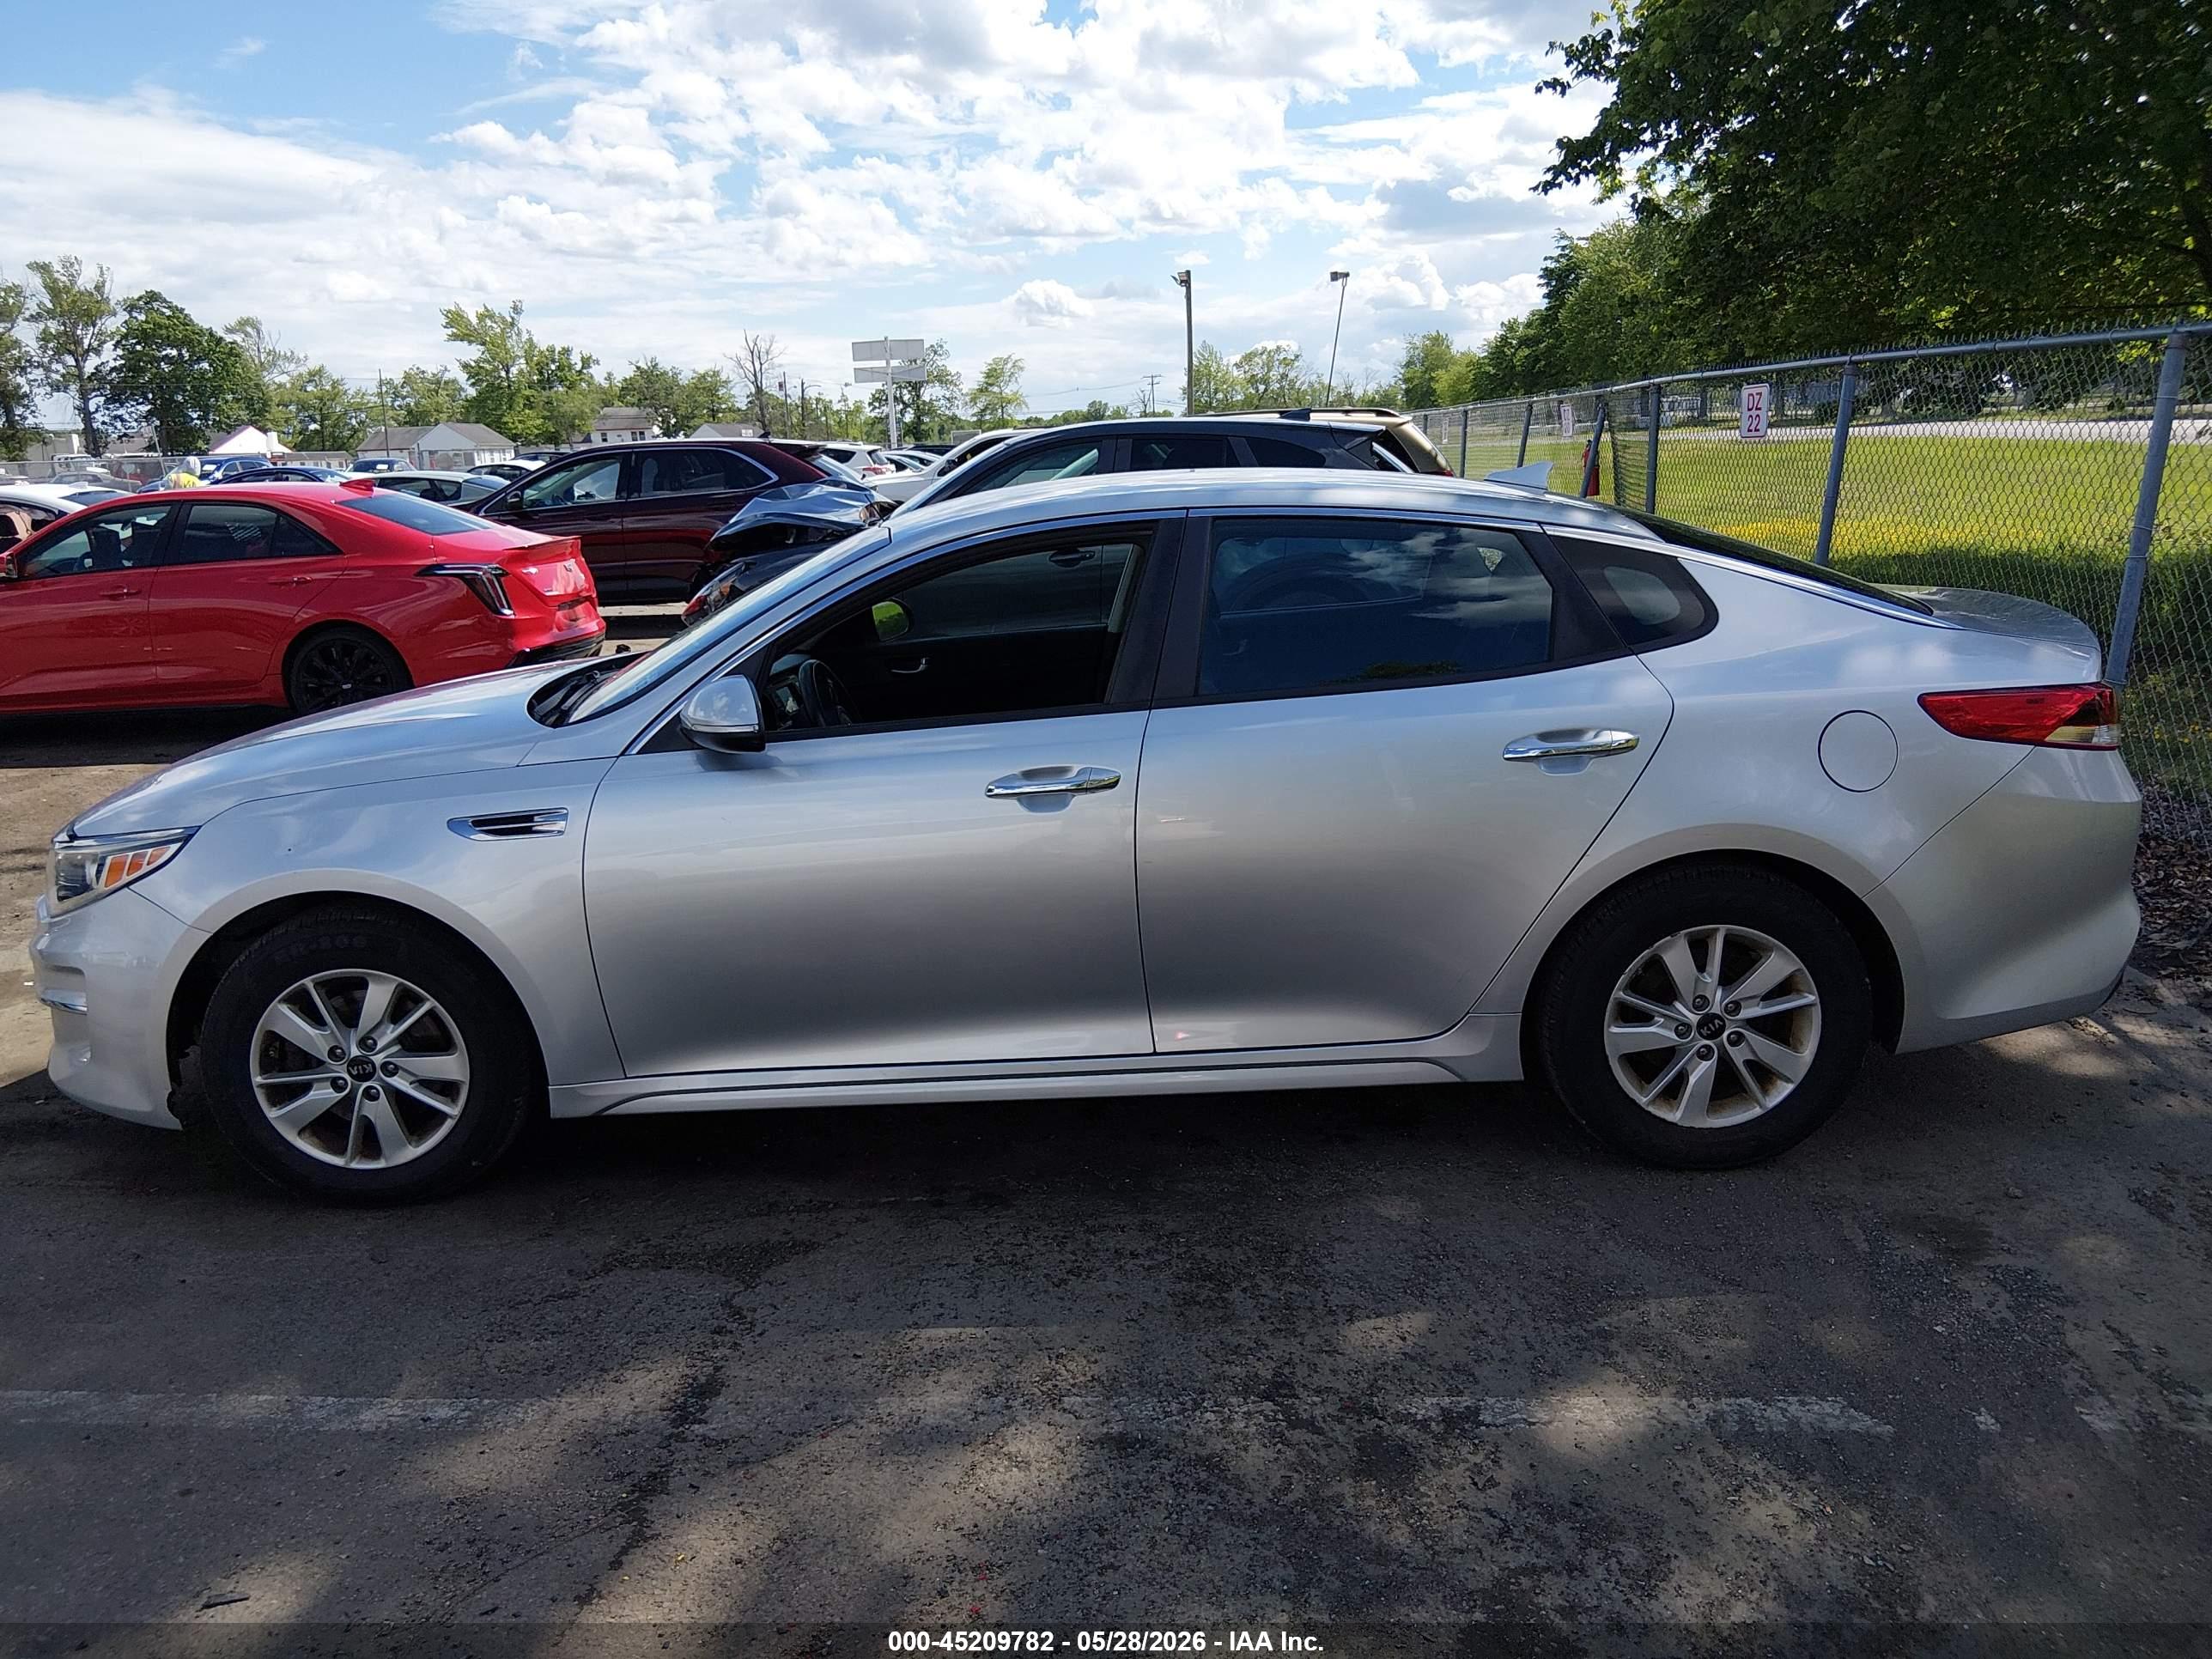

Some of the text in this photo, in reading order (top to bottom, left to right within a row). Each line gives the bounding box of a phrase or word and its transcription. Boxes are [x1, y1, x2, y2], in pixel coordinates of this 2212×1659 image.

[1747, 392, 1763, 412] DZ
[1747, 414, 1761, 433] 22
[1700, 1018, 1724, 1036] KIA
[349, 1063, 374, 1075] KIA
